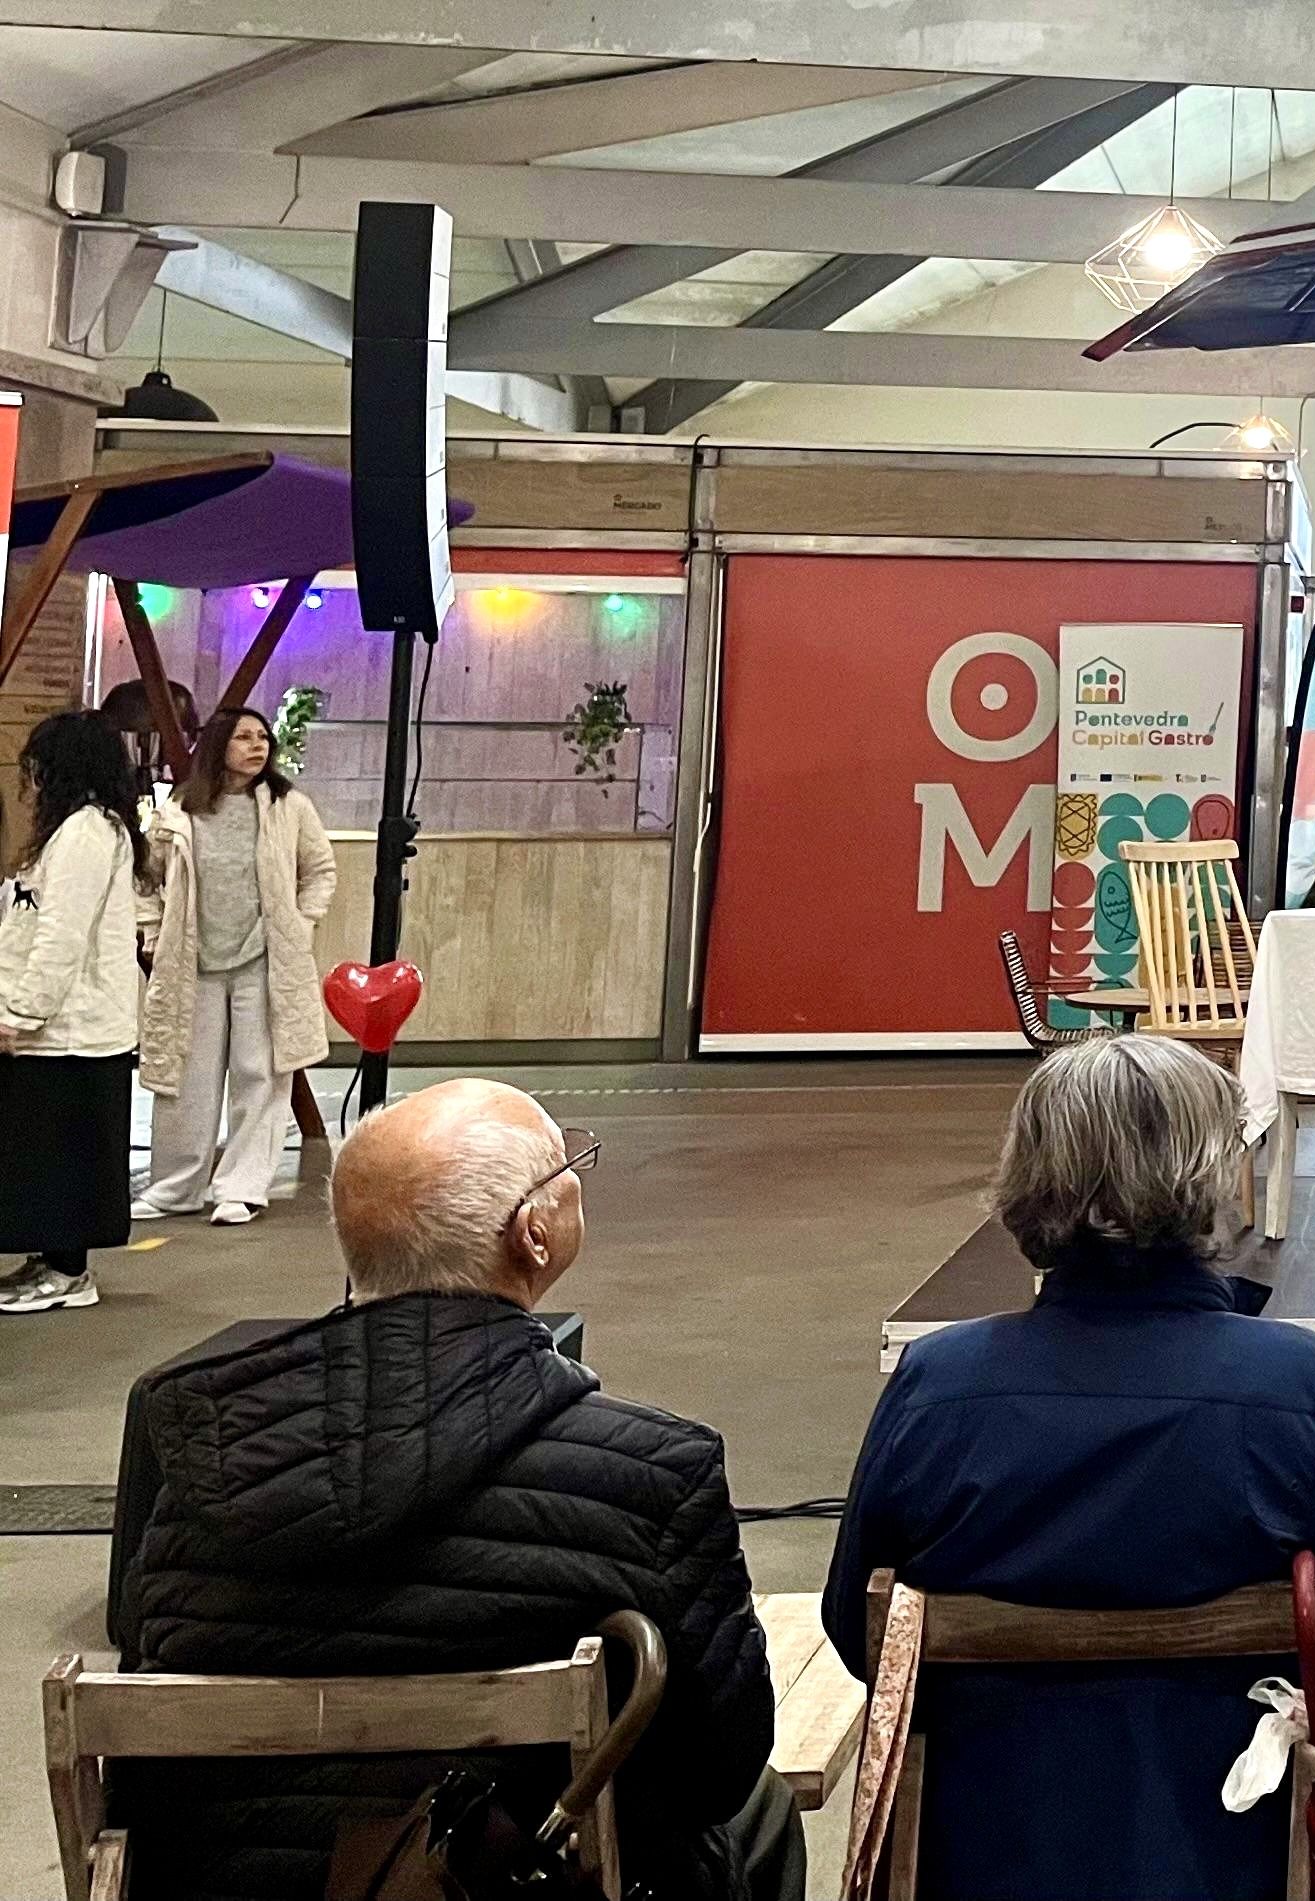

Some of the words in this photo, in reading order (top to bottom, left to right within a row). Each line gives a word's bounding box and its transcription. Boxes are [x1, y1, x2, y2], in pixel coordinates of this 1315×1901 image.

[1075, 711, 1188, 727] Pontevedra
[1072, 730, 1144, 750] Capital
[1149, 730, 1213, 746] Gastro
